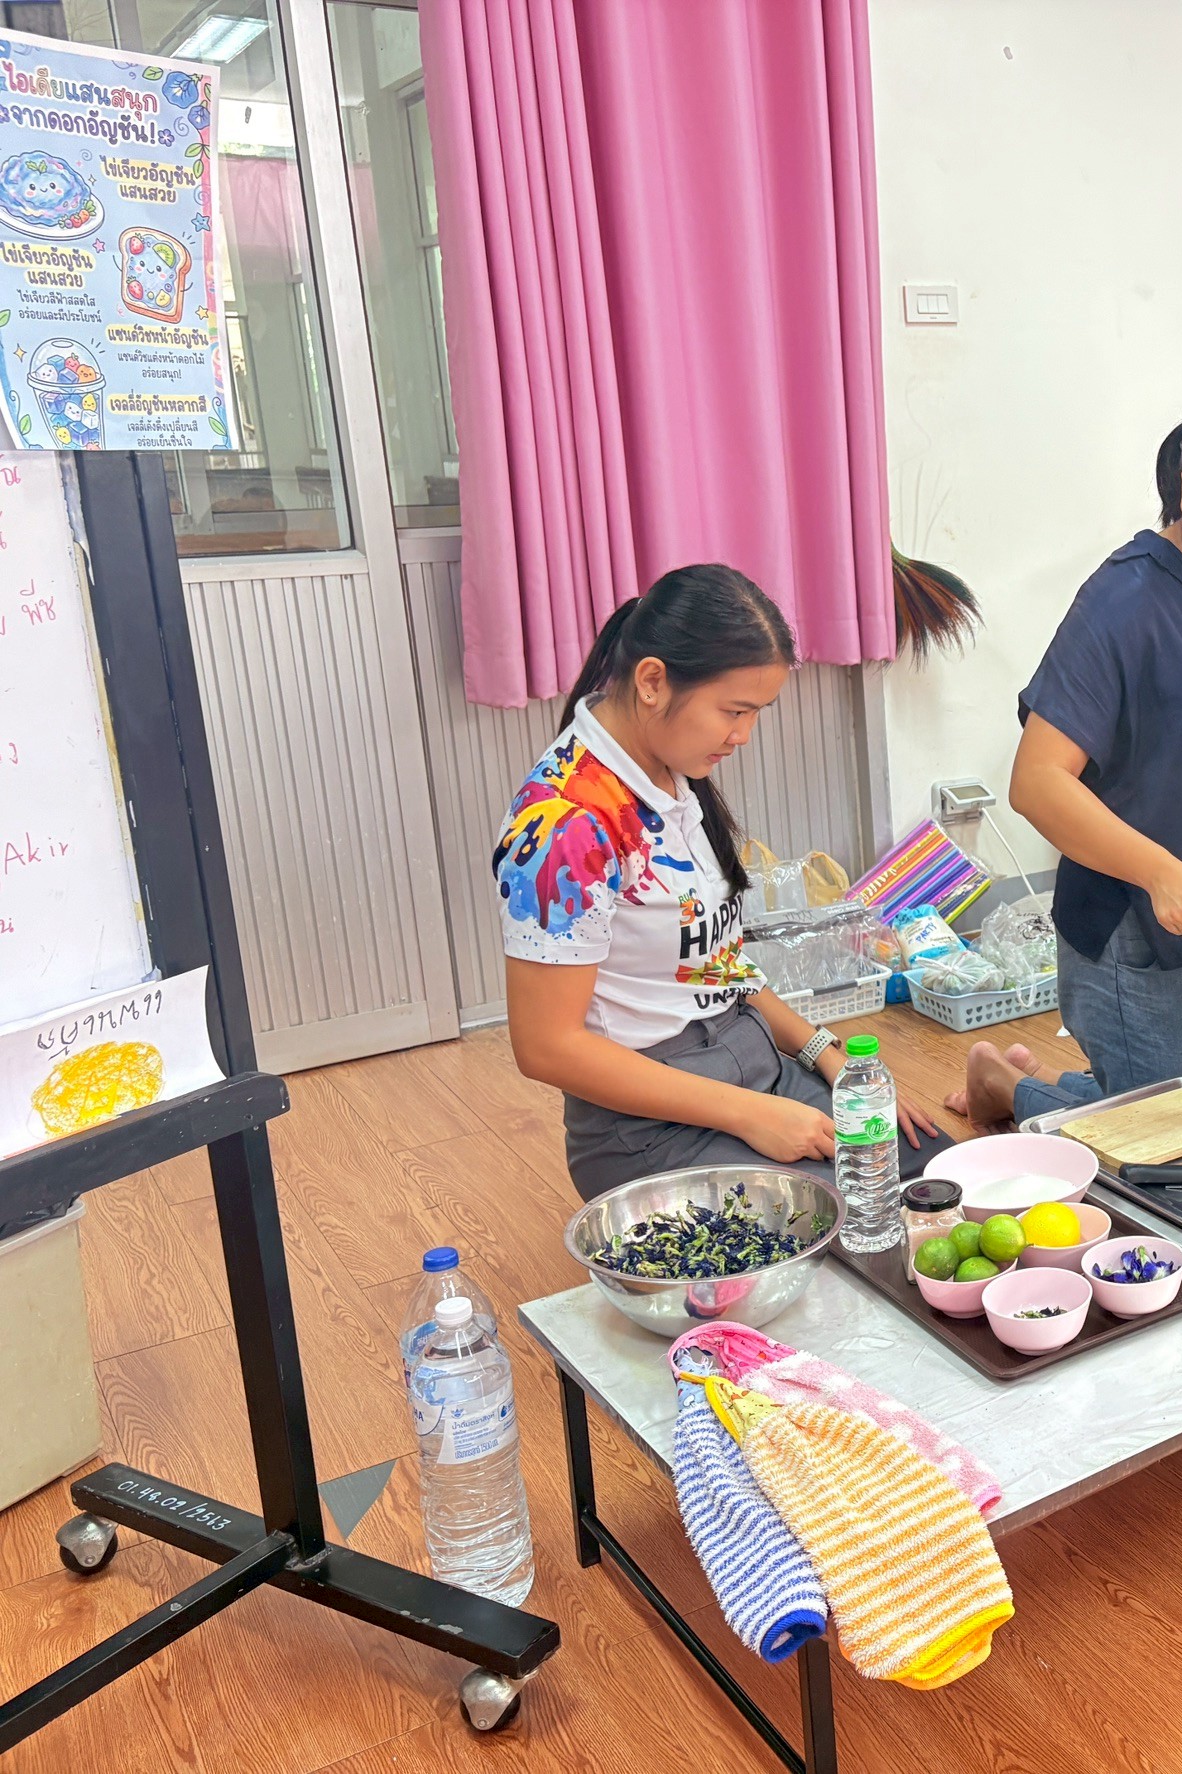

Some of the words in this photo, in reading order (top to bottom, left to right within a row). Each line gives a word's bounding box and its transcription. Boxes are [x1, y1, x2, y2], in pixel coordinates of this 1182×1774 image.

[2, 60, 158, 121] ไอเดียแสนสนุก
[10, 105, 156, 145] จากดอกอัญชัน!
[99, 154, 196, 188] ไข่เจียวอัญชัน
[120, 185, 176, 203] แสนสวย
[27, 271, 83, 287] แสนสวย
